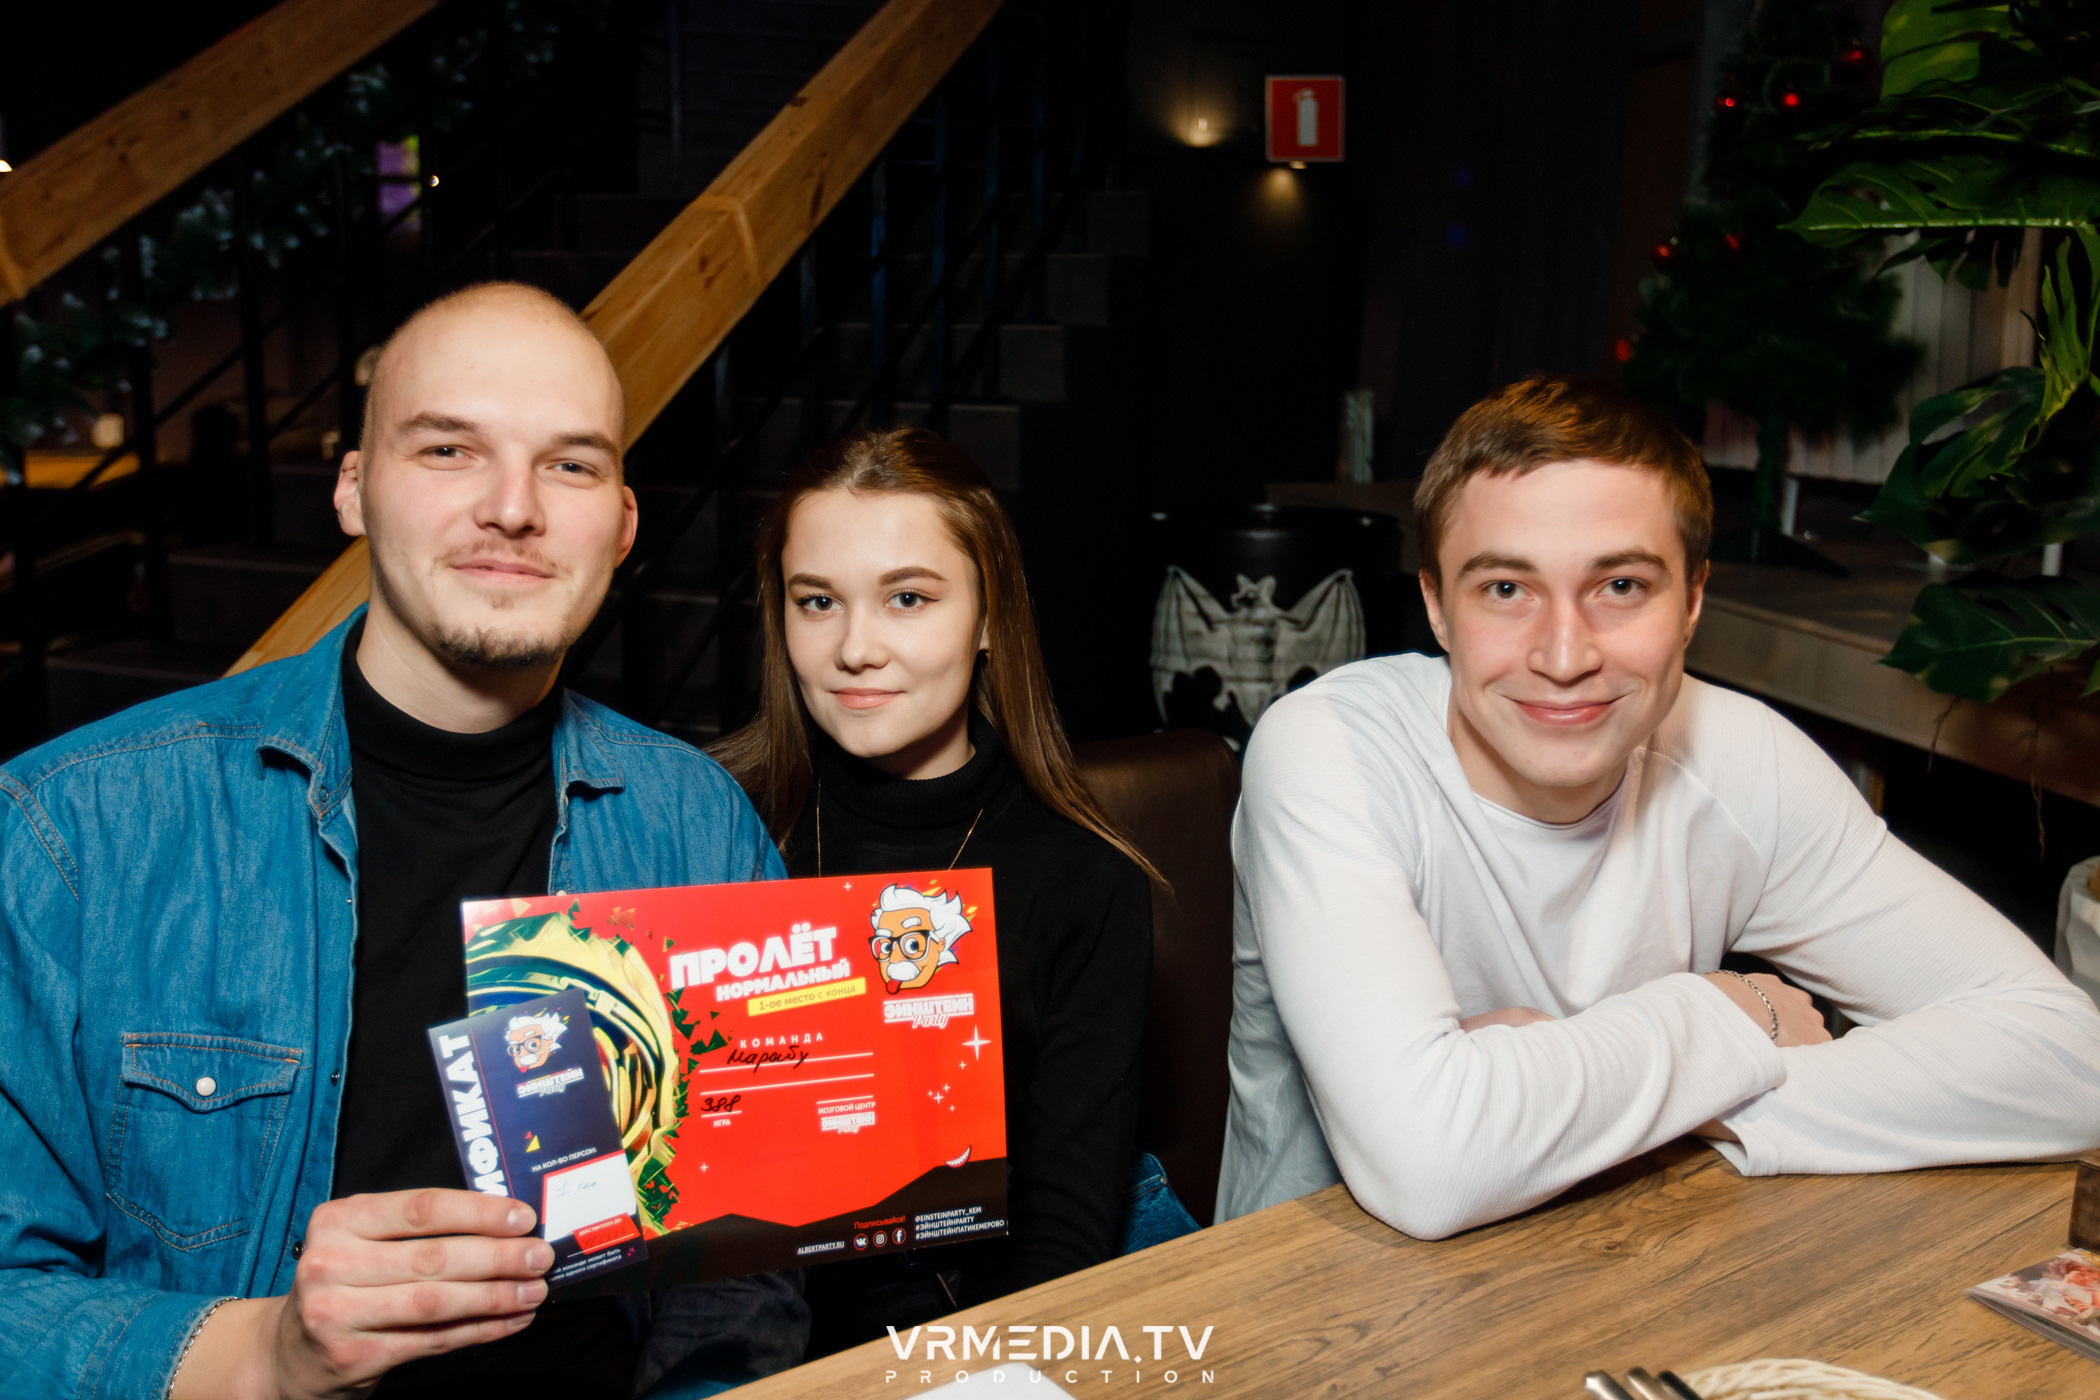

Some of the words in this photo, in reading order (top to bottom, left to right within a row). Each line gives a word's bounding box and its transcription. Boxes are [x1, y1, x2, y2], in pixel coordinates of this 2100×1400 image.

[670, 923, 837, 989] ПРОЛЁТ
[716, 959, 851, 1002] НОРМАЛЬНЫЙ
[759, 999, 782, 1011] 1-ое
[784, 991, 815, 1006] место
[817, 990, 824, 999] с
[826, 985, 856, 997] конца
[740, 1033, 824, 1049] КОМАНДА
[701, 1094, 741, 1112] 388
[818, 1103, 853, 1115] МОЗГОВОЙ
[855, 1101, 876, 1111] ЦЕНТР
[438, 1034, 508, 1198] ИФИКАТ
[713, 1118, 732, 1127] ИГРА
[542, 1156, 568, 1169] КОЛ-ВО
[854, 1215, 906, 1229] Подписывайся!
[915, 1206, 982, 1223] @EINSTEINPARTY_KEM
[797, 1241, 845, 1254] ALBERTPARTY.RU
